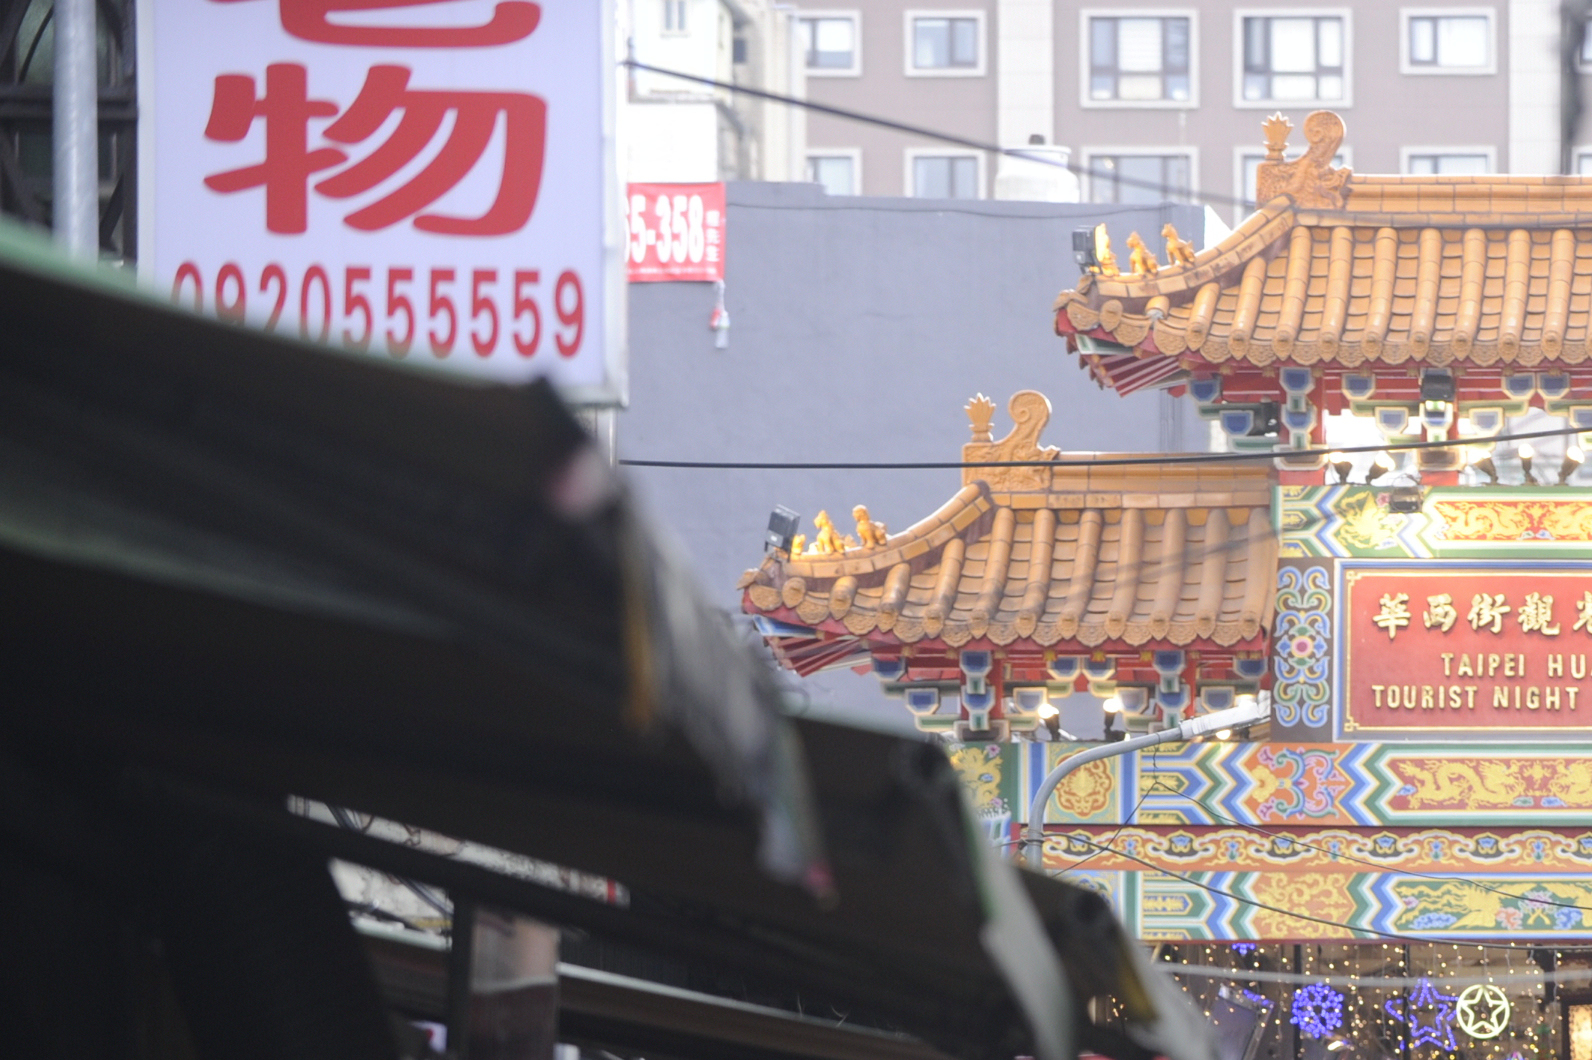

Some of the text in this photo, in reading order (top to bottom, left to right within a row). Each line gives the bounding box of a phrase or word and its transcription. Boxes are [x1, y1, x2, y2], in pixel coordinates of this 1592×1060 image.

[624, 193, 705, 263] 5-358
[1441, 652, 1526, 678] TAIPEI
[1371, 684, 1478, 710] TOURIST
[1492, 685, 1580, 711] NIGHT
